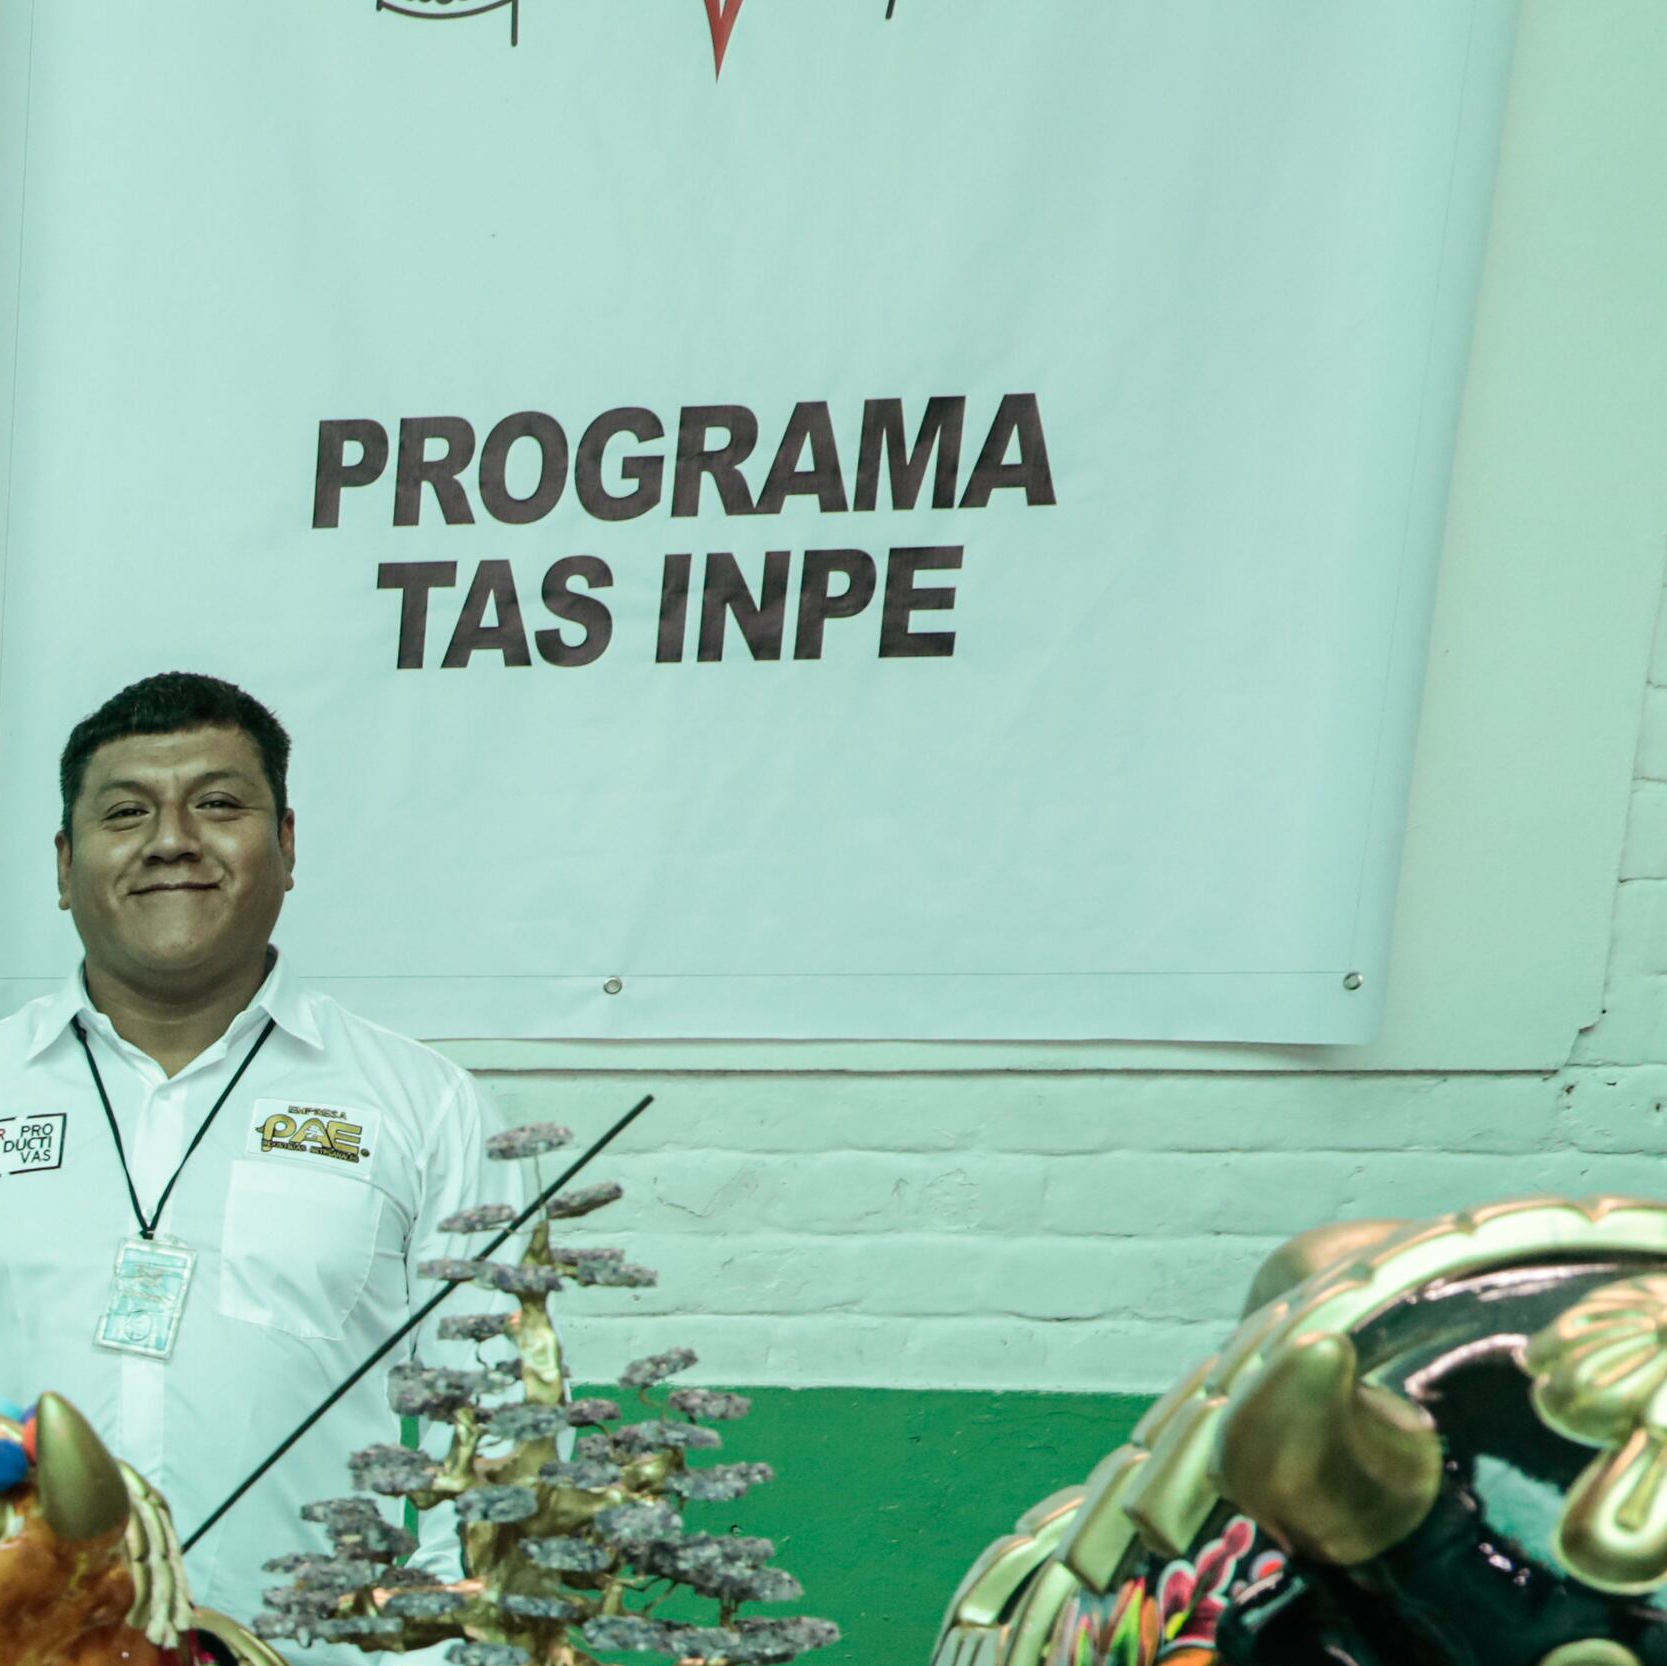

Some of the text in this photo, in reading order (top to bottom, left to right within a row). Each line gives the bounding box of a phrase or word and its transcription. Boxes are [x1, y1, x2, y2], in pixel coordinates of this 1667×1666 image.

[312, 392, 1058, 529] PROGRAMA
[376, 545, 964, 670] TAS INPE
[21, 1123, 54, 1138] PRO
[3, 1136, 52, 1153] DUCTI
[20, 1149, 51, 1163] VAS
